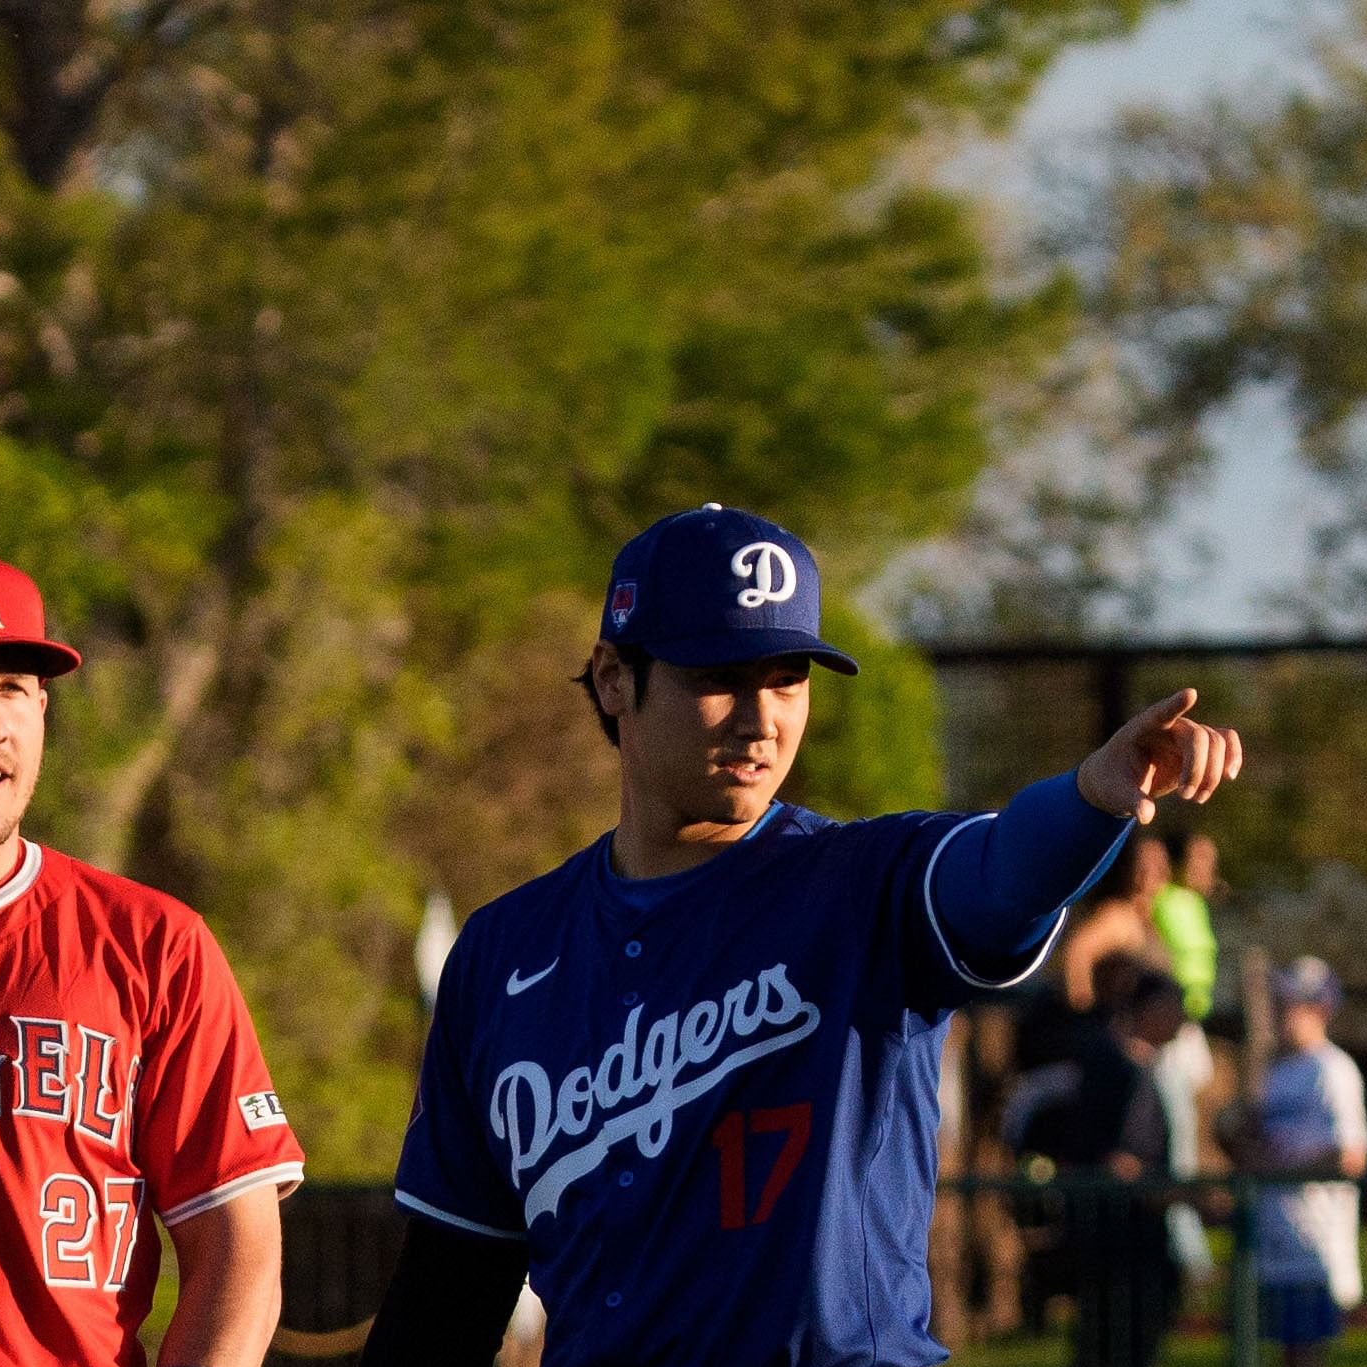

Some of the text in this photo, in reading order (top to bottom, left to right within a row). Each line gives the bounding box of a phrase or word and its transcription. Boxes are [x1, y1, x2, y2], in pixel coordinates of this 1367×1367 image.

[731, 541, 797, 608] D
[490, 963, 802, 1190] Dodgers
[712, 1103, 812, 1229] 17
[39, 1173, 145, 1291] 27
